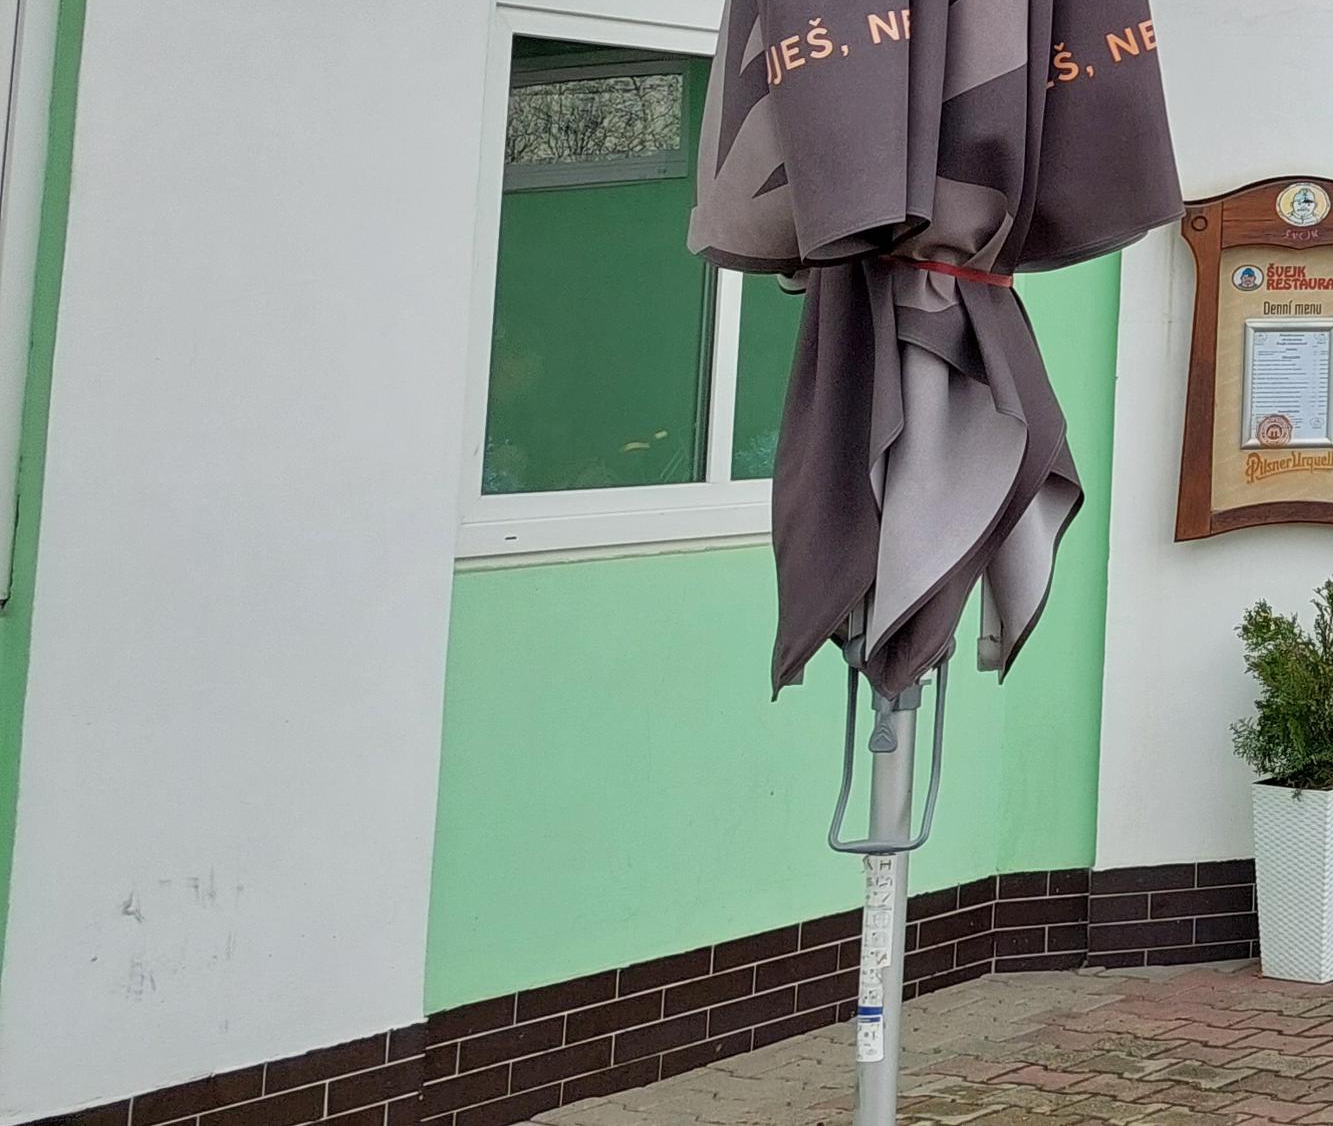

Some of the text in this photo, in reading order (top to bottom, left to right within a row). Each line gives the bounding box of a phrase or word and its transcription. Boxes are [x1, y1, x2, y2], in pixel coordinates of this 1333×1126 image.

[1266, 263, 1306, 278] ŠVEJK
[1263, 300, 1322, 315] Denní menu
[1245, 452, 1292, 484] Pilsner
